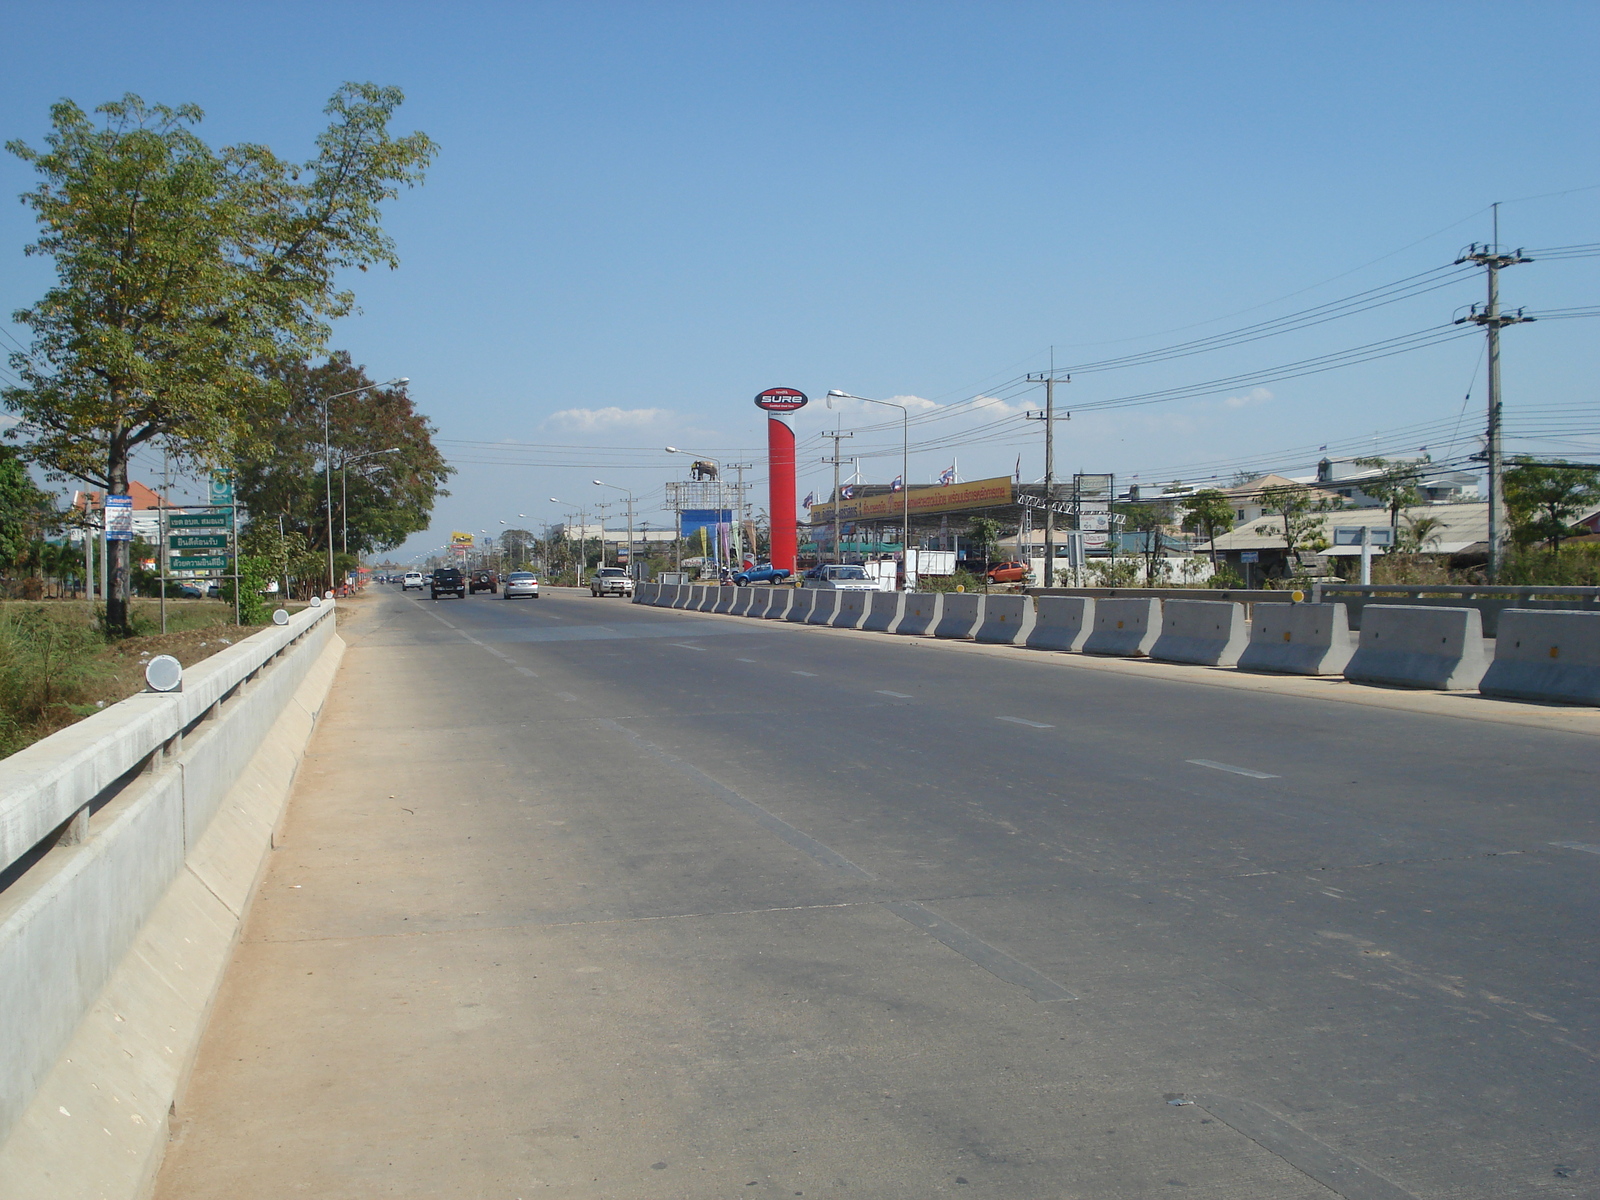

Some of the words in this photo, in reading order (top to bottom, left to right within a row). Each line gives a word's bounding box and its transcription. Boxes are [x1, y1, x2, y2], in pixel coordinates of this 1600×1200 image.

[761, 395, 802, 403] SURE
[177, 537, 218, 546] ยินดีต้อนรับ
